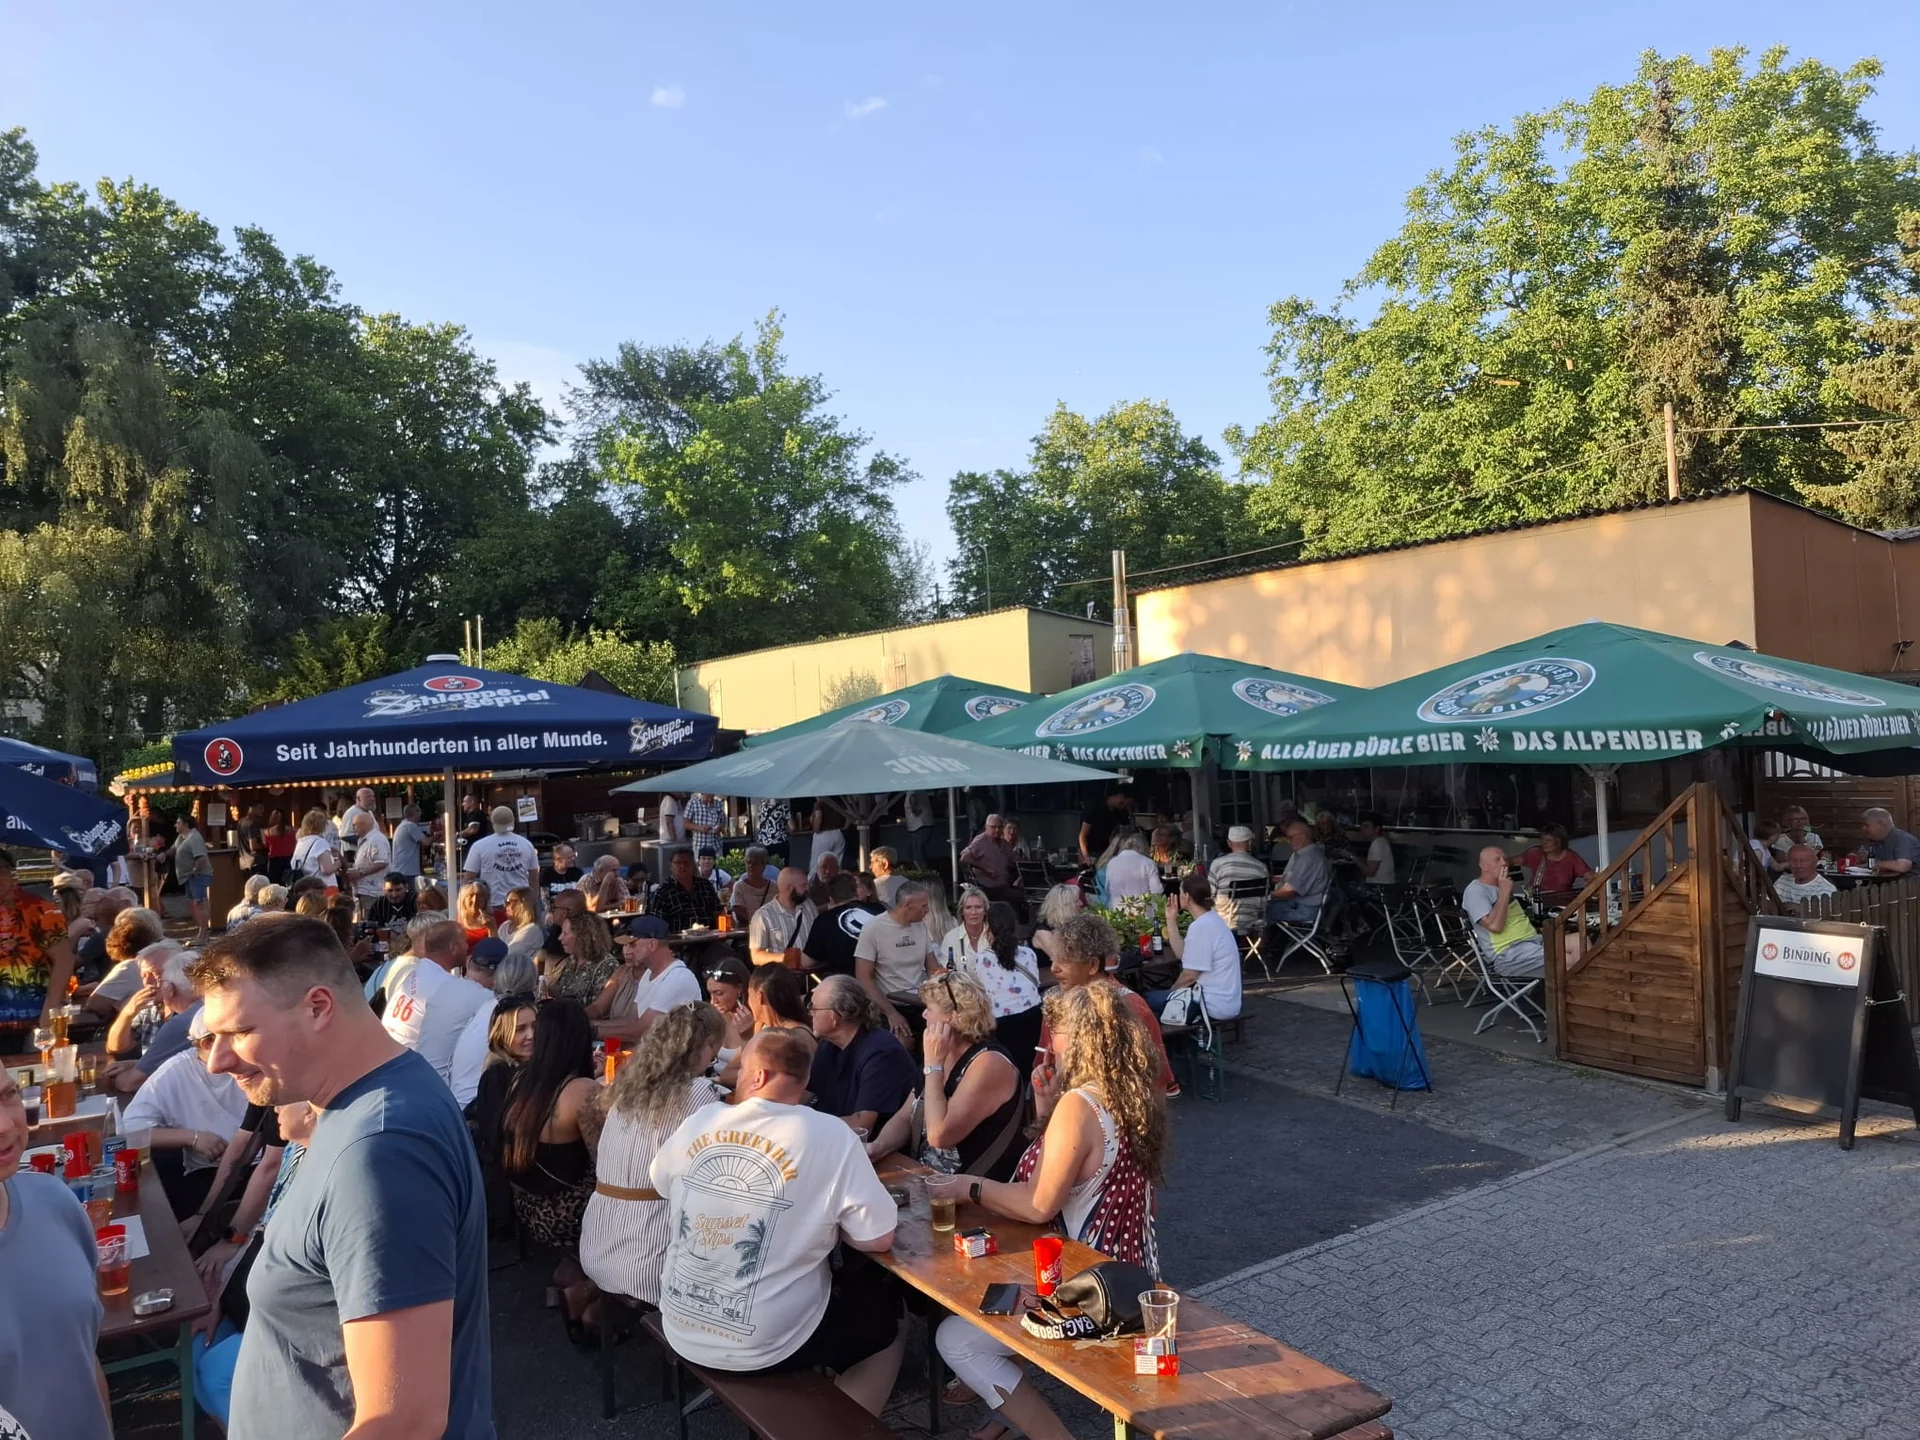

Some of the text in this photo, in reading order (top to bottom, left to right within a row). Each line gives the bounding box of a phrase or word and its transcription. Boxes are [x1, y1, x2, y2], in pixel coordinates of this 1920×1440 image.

[1889, 715, 1911, 737] BIER
[276, 730, 608, 762] Seit Jahrhunderten in aller Munde.
[1261, 731, 1466, 760] ALLGÄUER BÜBLE BIER
[1512, 729, 1704, 751] DAS ALPENBIER
[1072, 744, 1168, 761] DAS ALPENBIER
[1782, 946, 1832, 965] BINDING
[685, 1132, 713, 1161] THE
[693, 1212, 750, 1231] Sunset
[698, 1228, 735, 1251] Sips
